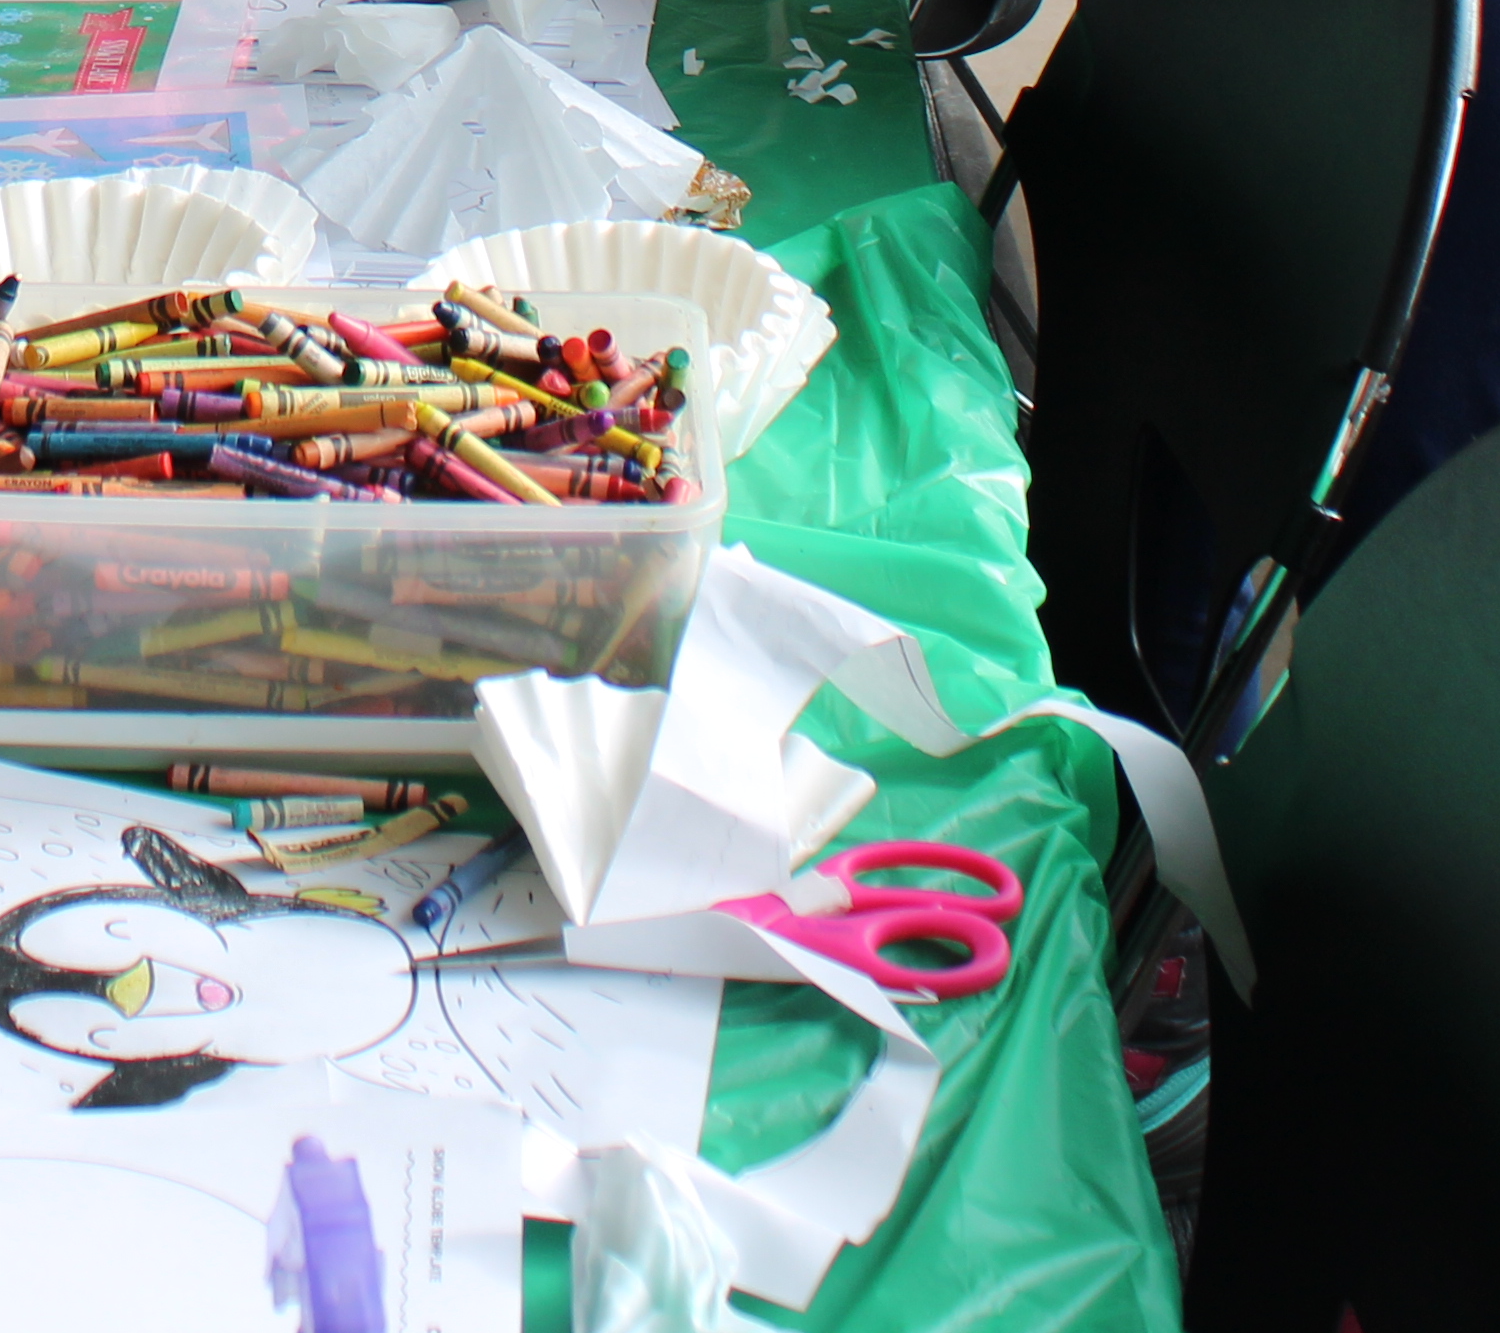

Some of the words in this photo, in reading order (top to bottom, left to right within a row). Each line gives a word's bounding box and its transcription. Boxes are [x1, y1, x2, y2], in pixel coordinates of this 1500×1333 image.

[122, 565, 227, 591] Crayola
[433, 1147, 445, 1182] SNOW
[431, 1185, 444, 1227] GLOBE
[429, 1228, 444, 1284] TEMPLATE
